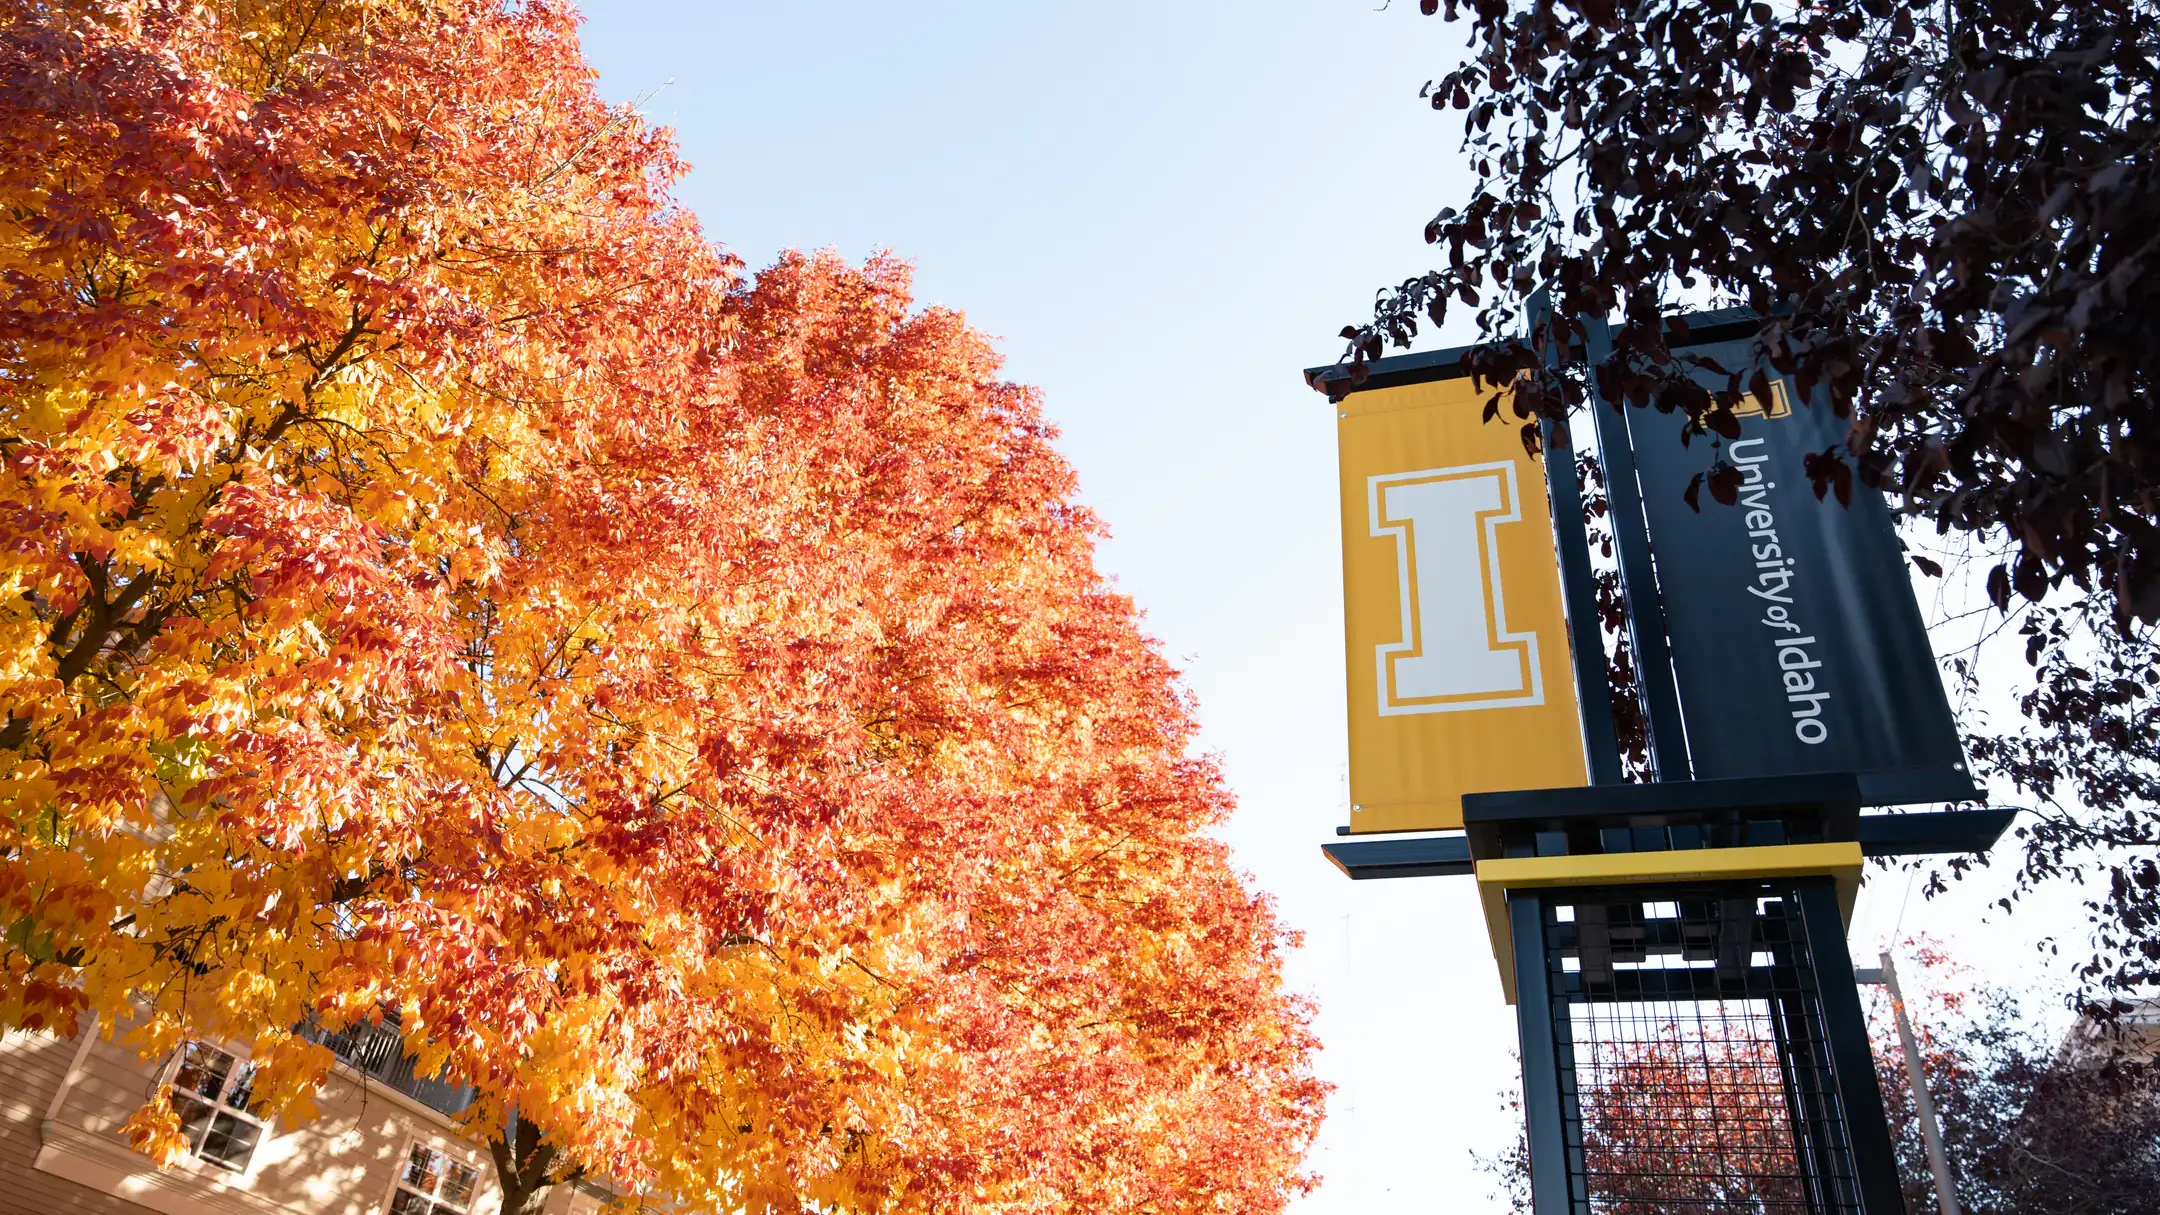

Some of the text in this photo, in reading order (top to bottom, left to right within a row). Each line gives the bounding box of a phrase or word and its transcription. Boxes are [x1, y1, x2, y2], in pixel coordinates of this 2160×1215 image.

[1367, 459, 1545, 717] I
[1728, 437, 1795, 603] University
[1761, 605, 1801, 634] of
[1774, 635, 1831, 745] Idaho
